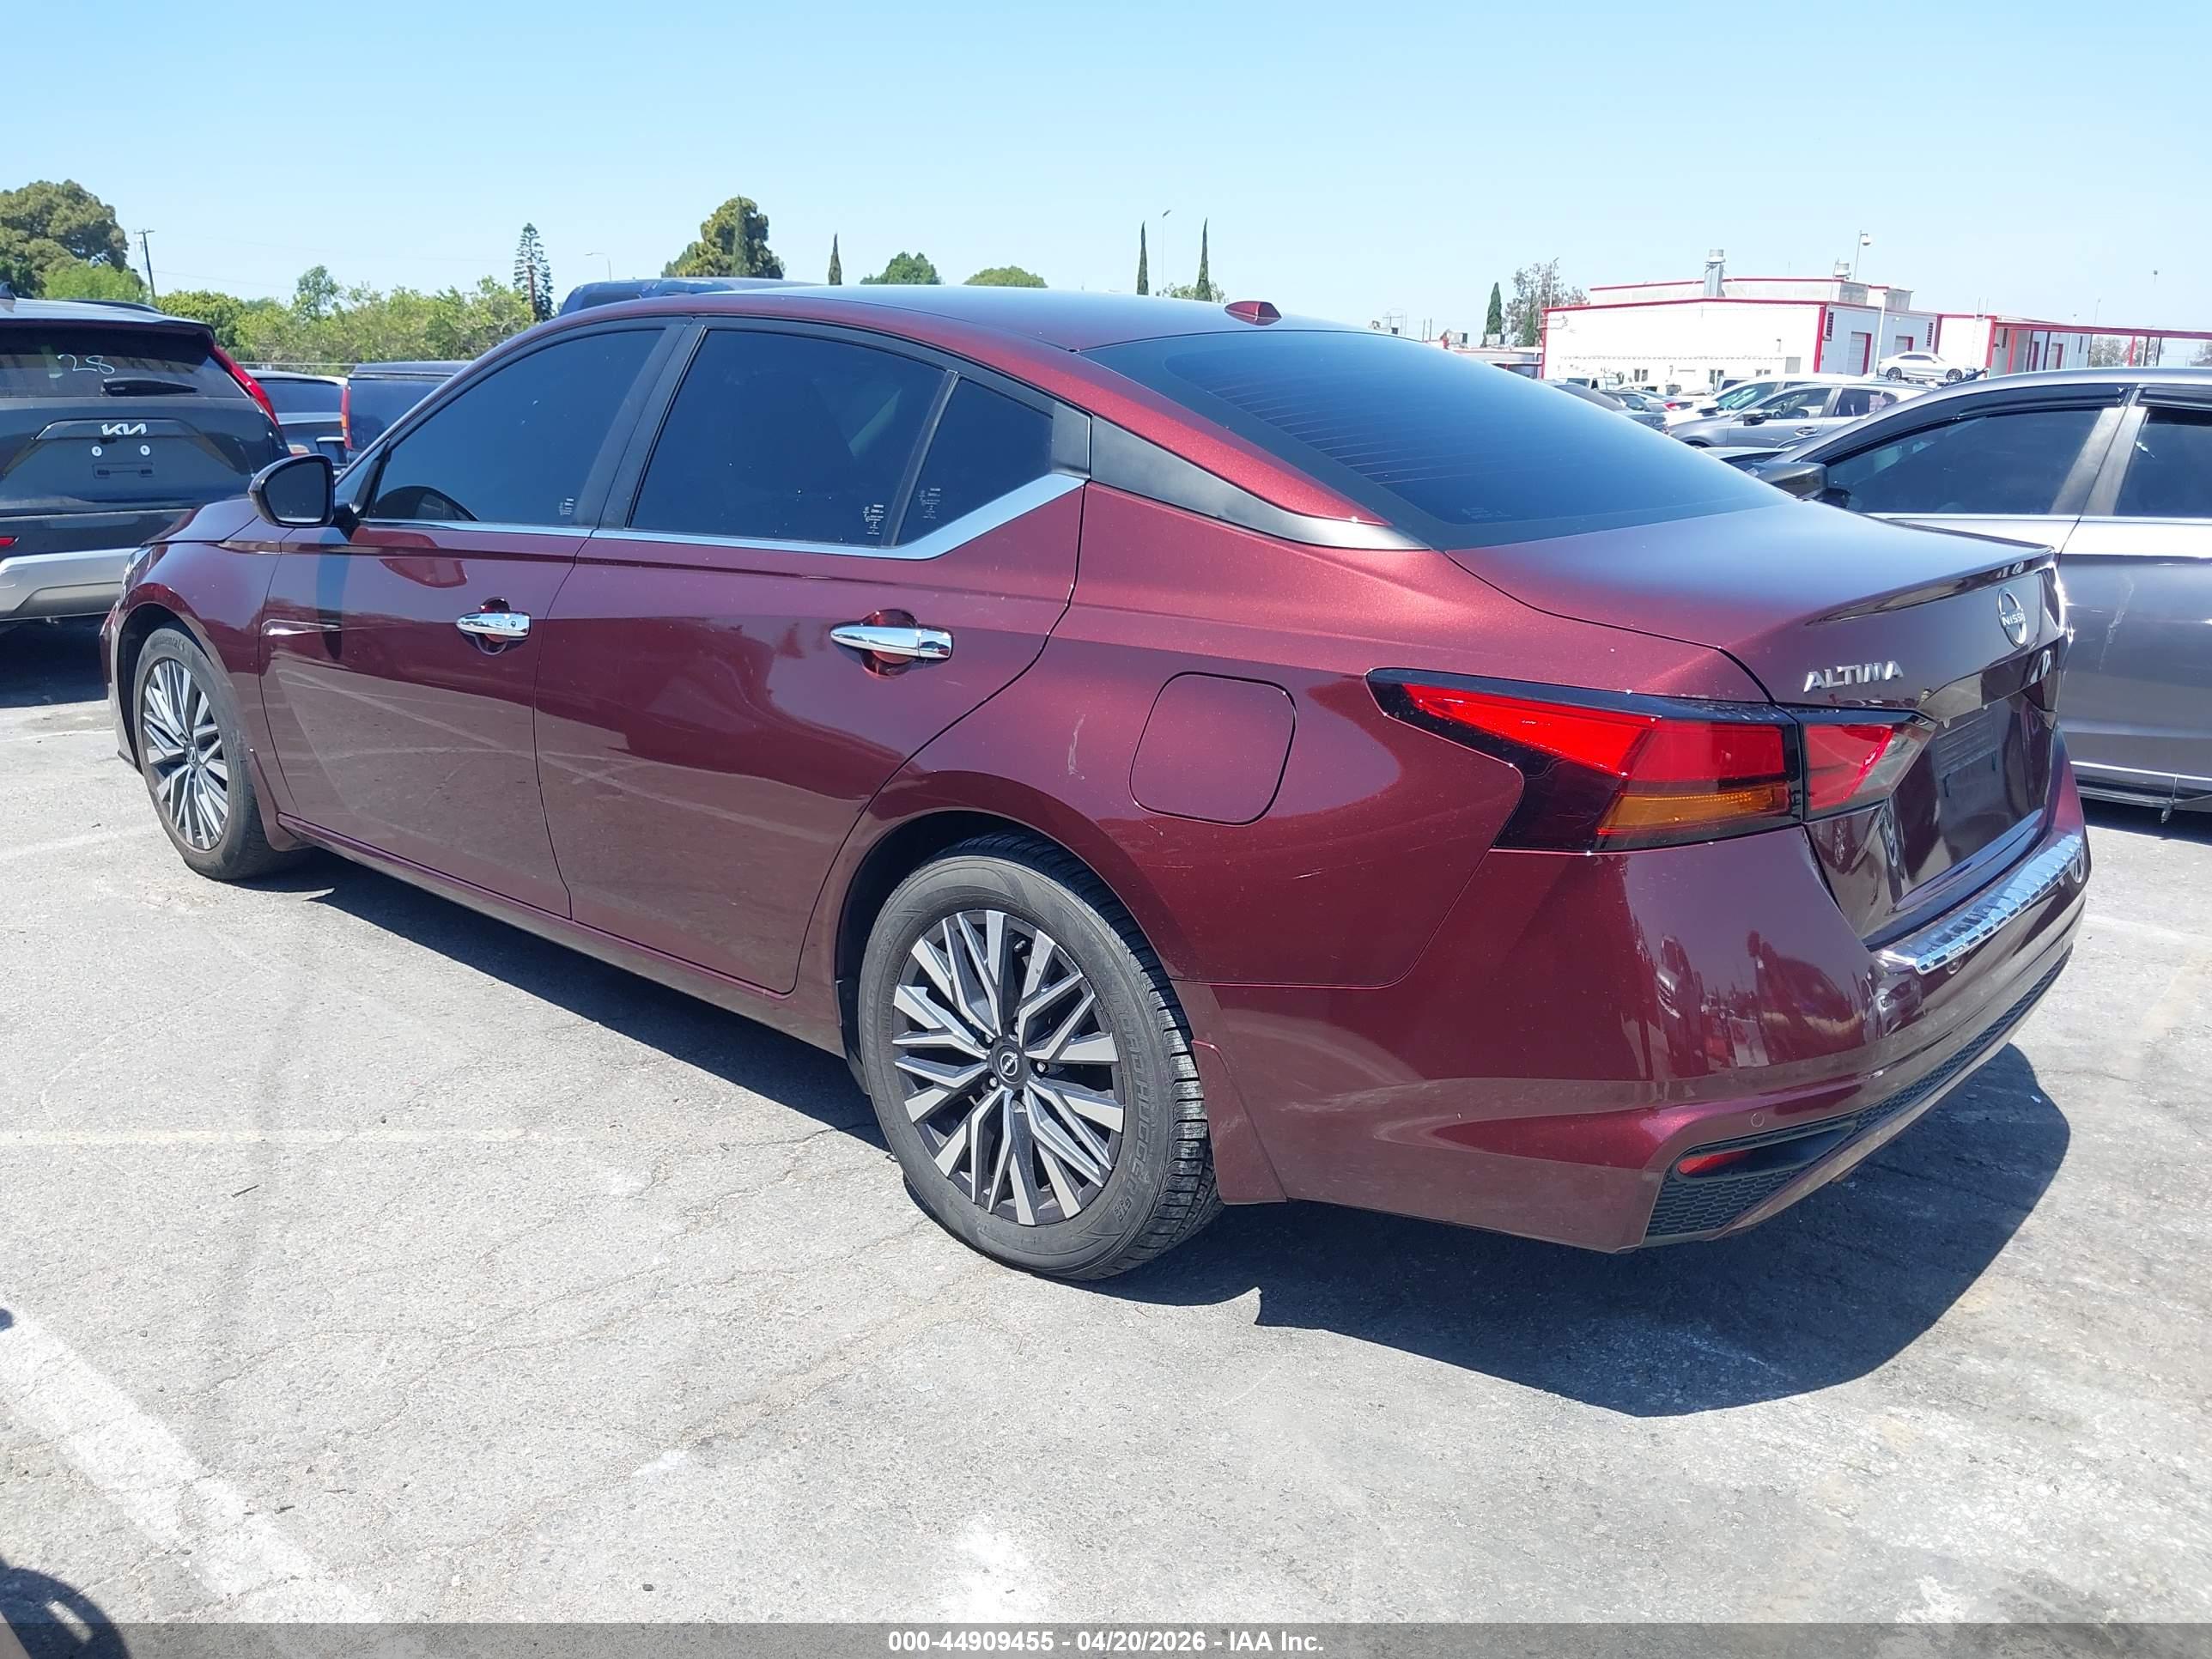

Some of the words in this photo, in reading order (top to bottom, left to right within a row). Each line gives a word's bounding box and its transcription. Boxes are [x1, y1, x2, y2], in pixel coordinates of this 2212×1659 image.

[58, 353, 115, 374] 28
[101, 423, 147, 435] KIA
[1802, 660, 1904, 693] ALTIMA
